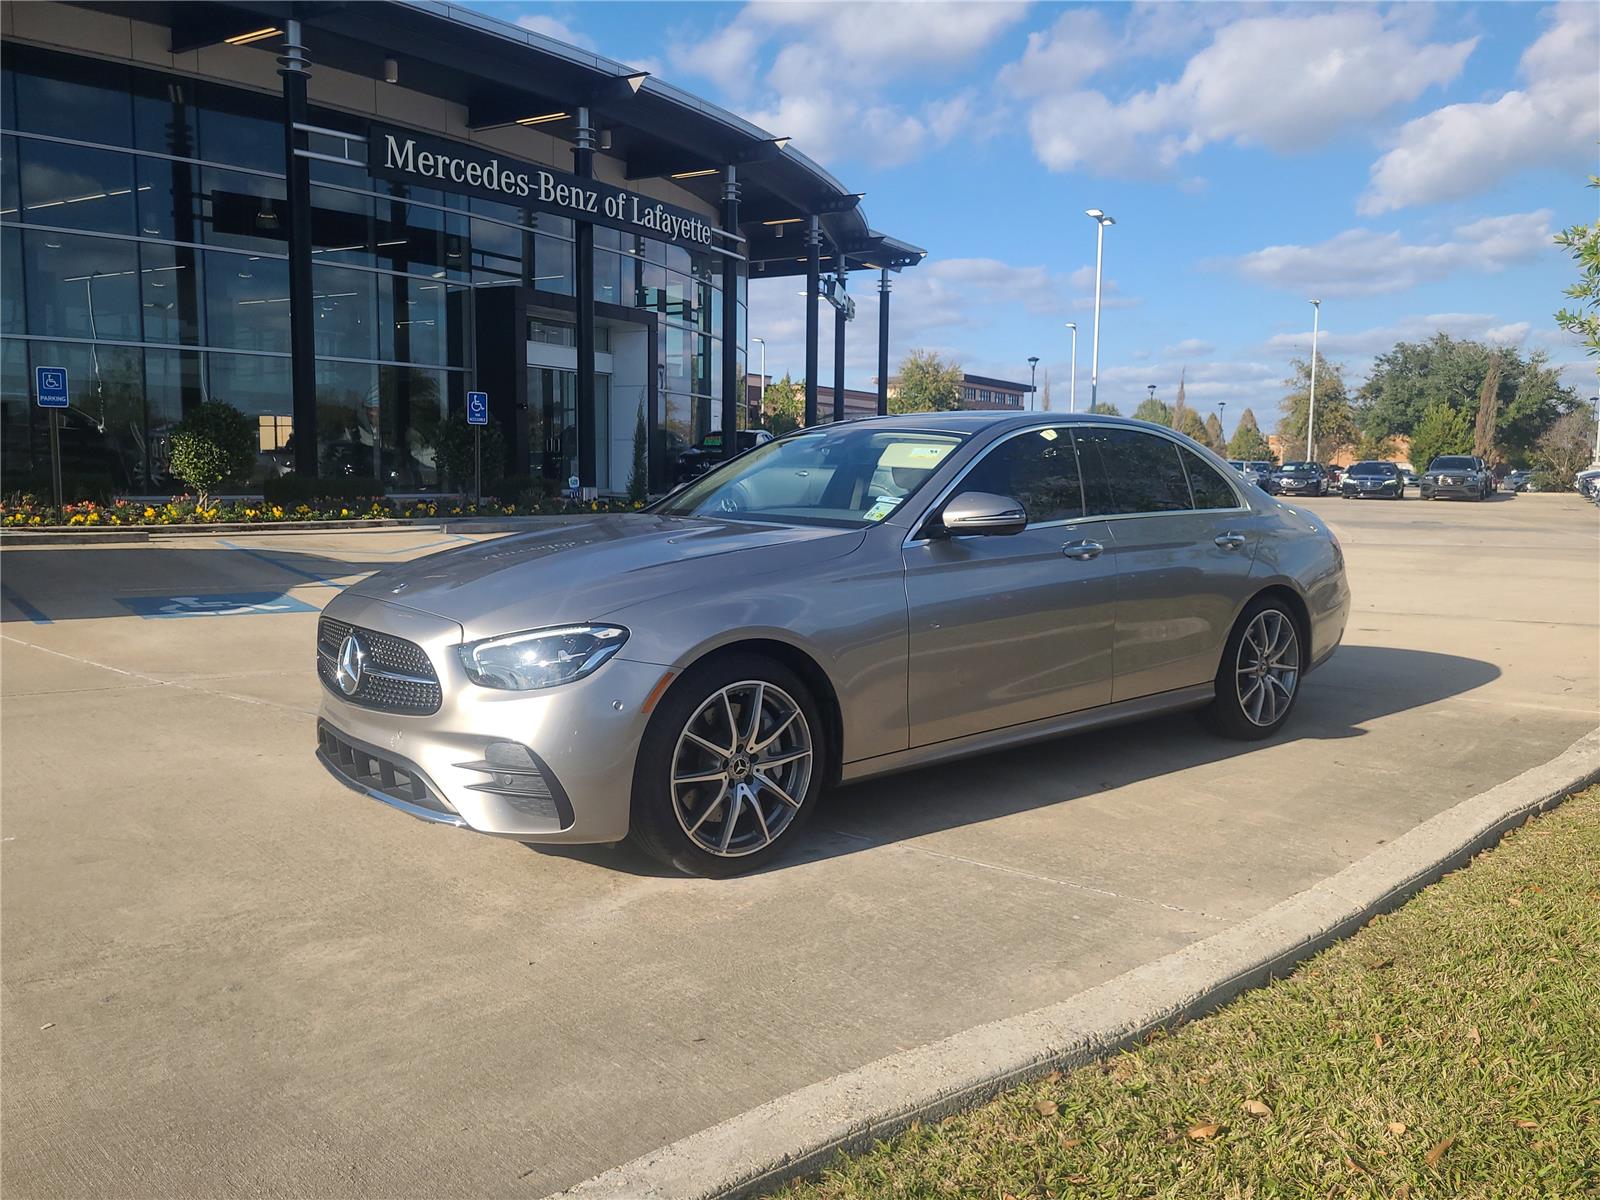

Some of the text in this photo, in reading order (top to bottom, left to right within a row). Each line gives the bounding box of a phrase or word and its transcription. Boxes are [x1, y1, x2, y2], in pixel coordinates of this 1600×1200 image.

[384, 134, 712, 246] Mercedes-Benz of Lafayette
